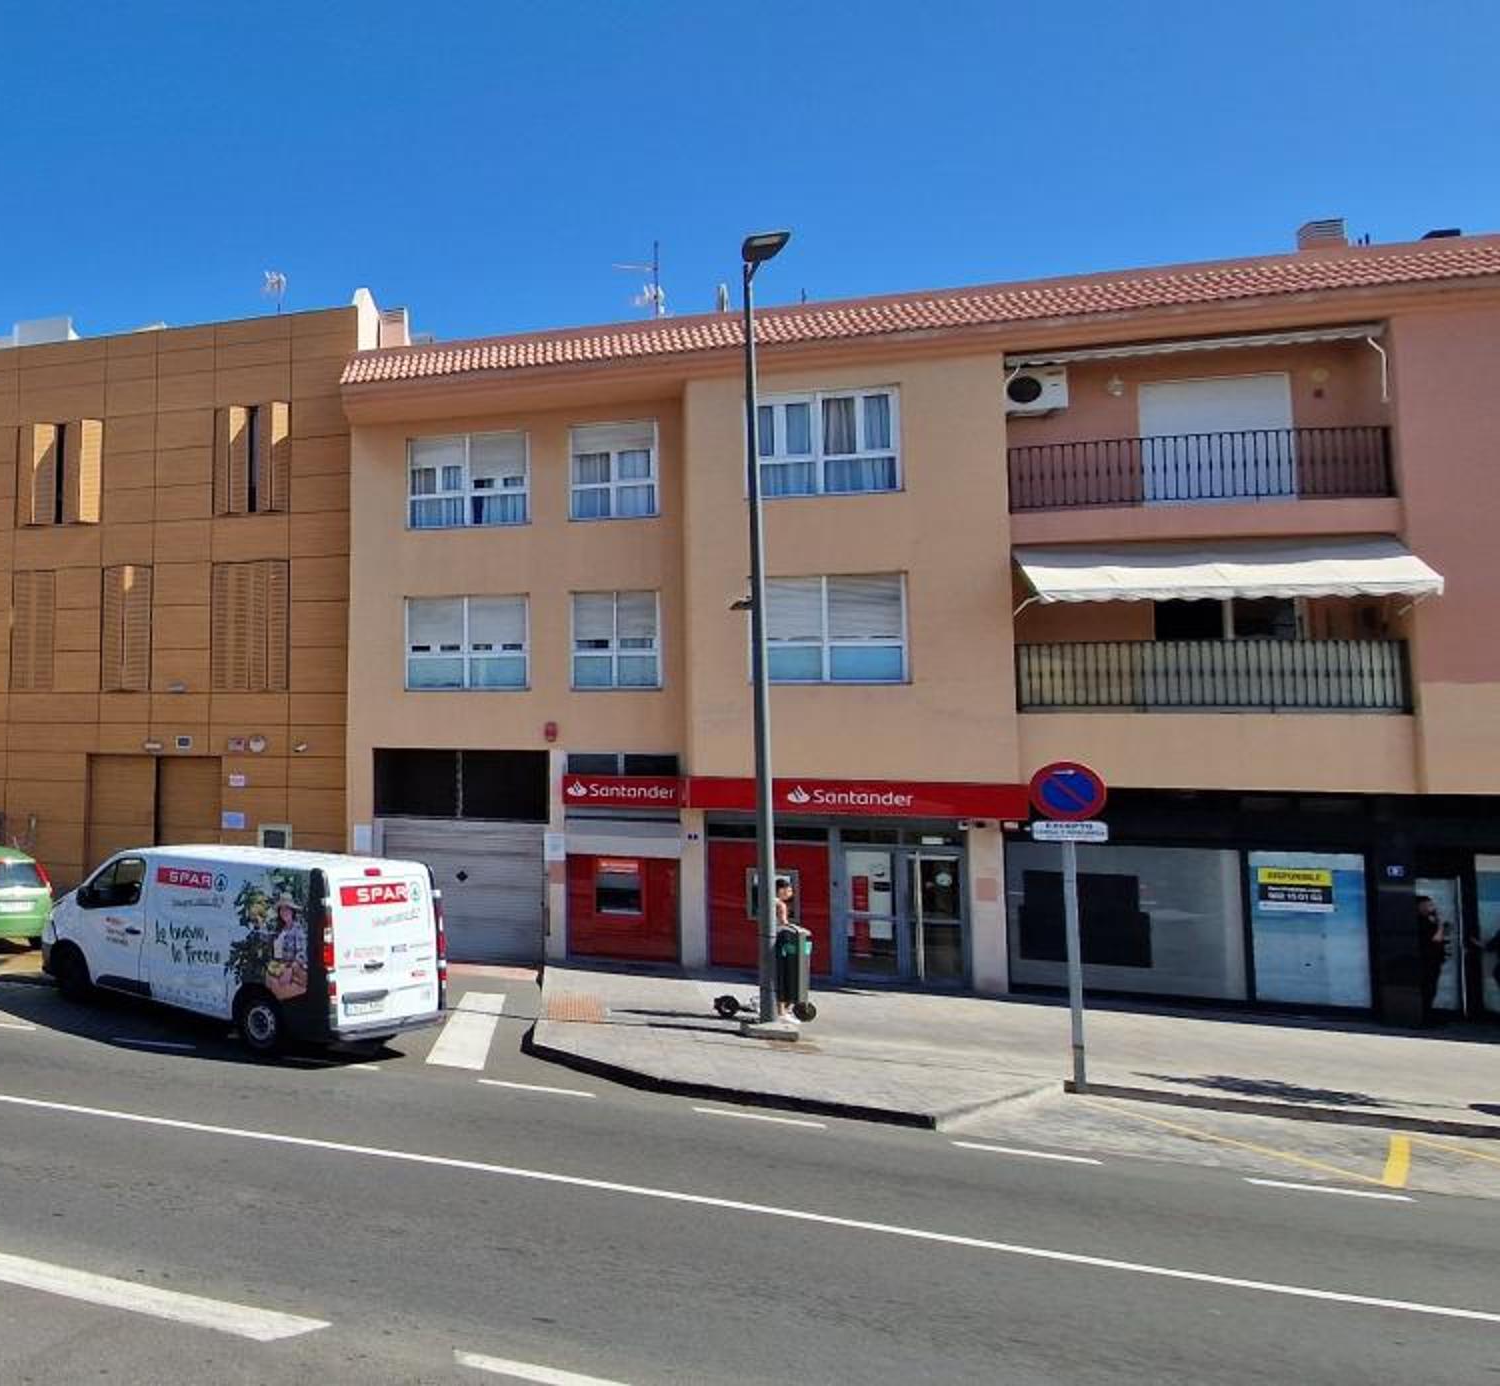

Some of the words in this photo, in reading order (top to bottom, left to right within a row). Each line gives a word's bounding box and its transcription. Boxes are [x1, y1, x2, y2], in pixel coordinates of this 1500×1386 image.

[588, 783, 676, 799] Santander
[812, 789, 913, 806] Santander
[168, 871, 211, 887] SPAR
[356, 886, 408, 903] SPAR
